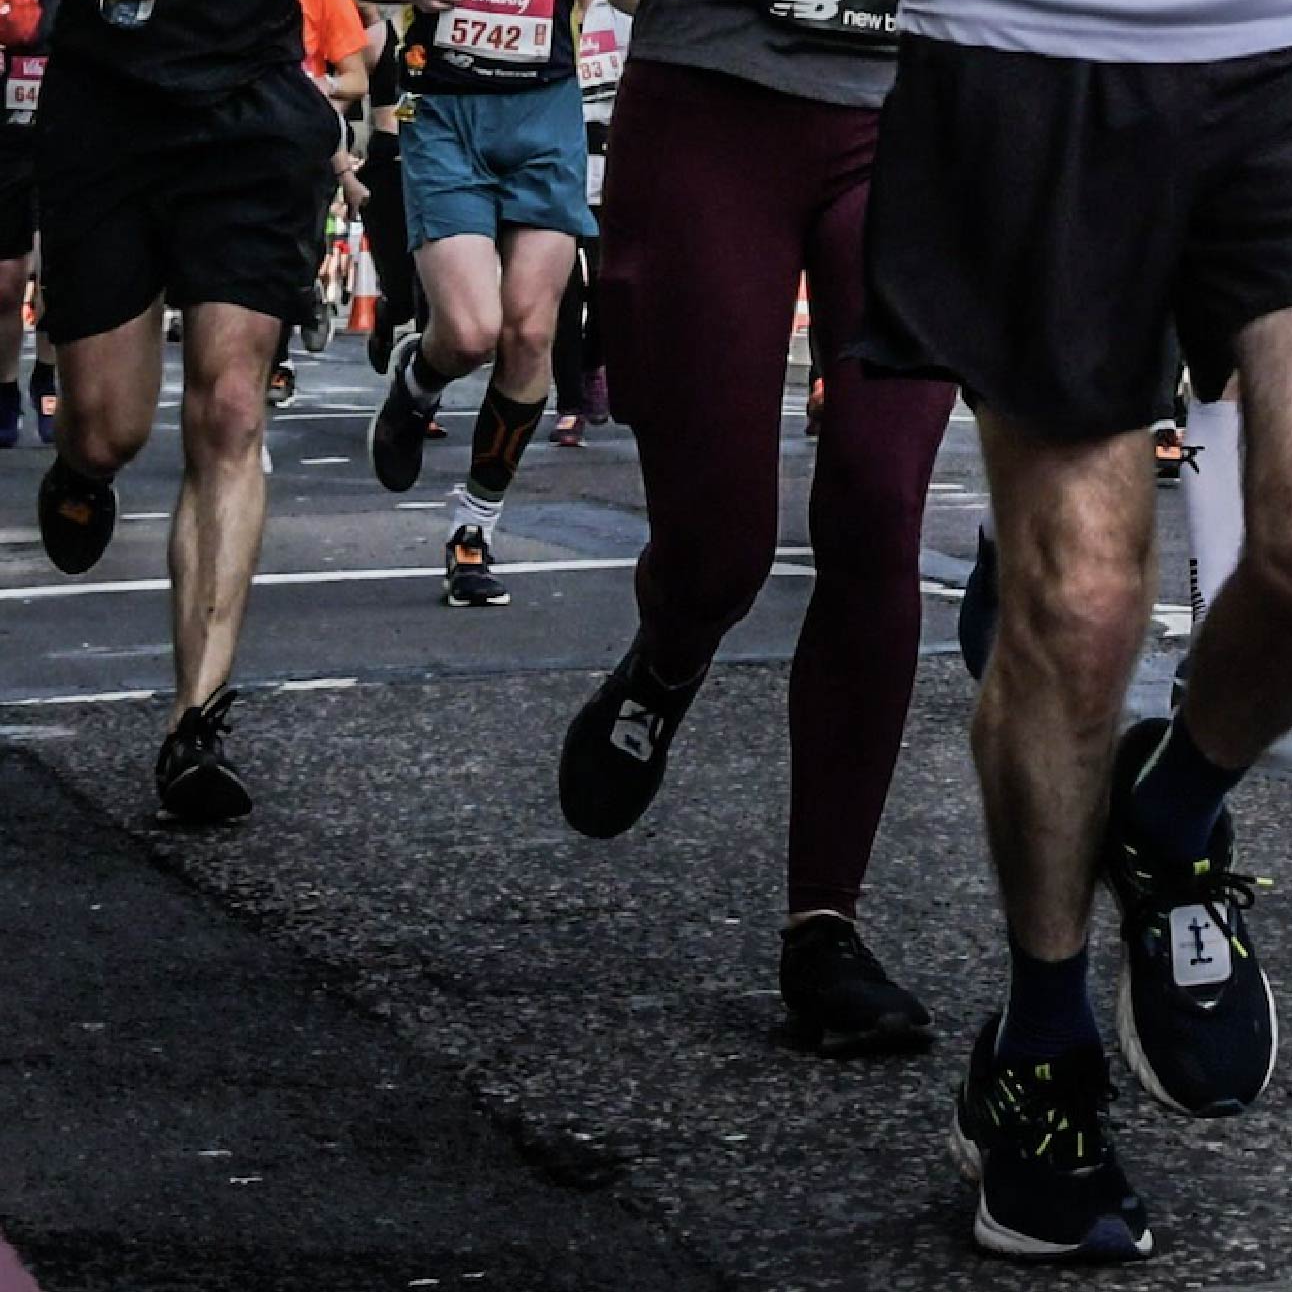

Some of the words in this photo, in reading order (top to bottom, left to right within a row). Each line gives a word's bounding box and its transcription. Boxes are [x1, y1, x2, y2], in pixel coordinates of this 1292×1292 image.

[842, 7, 882, 31] new
[451, 17, 522, 51] 5742
[580, 61, 604, 81] 83
[14, 85, 36, 103] 64
